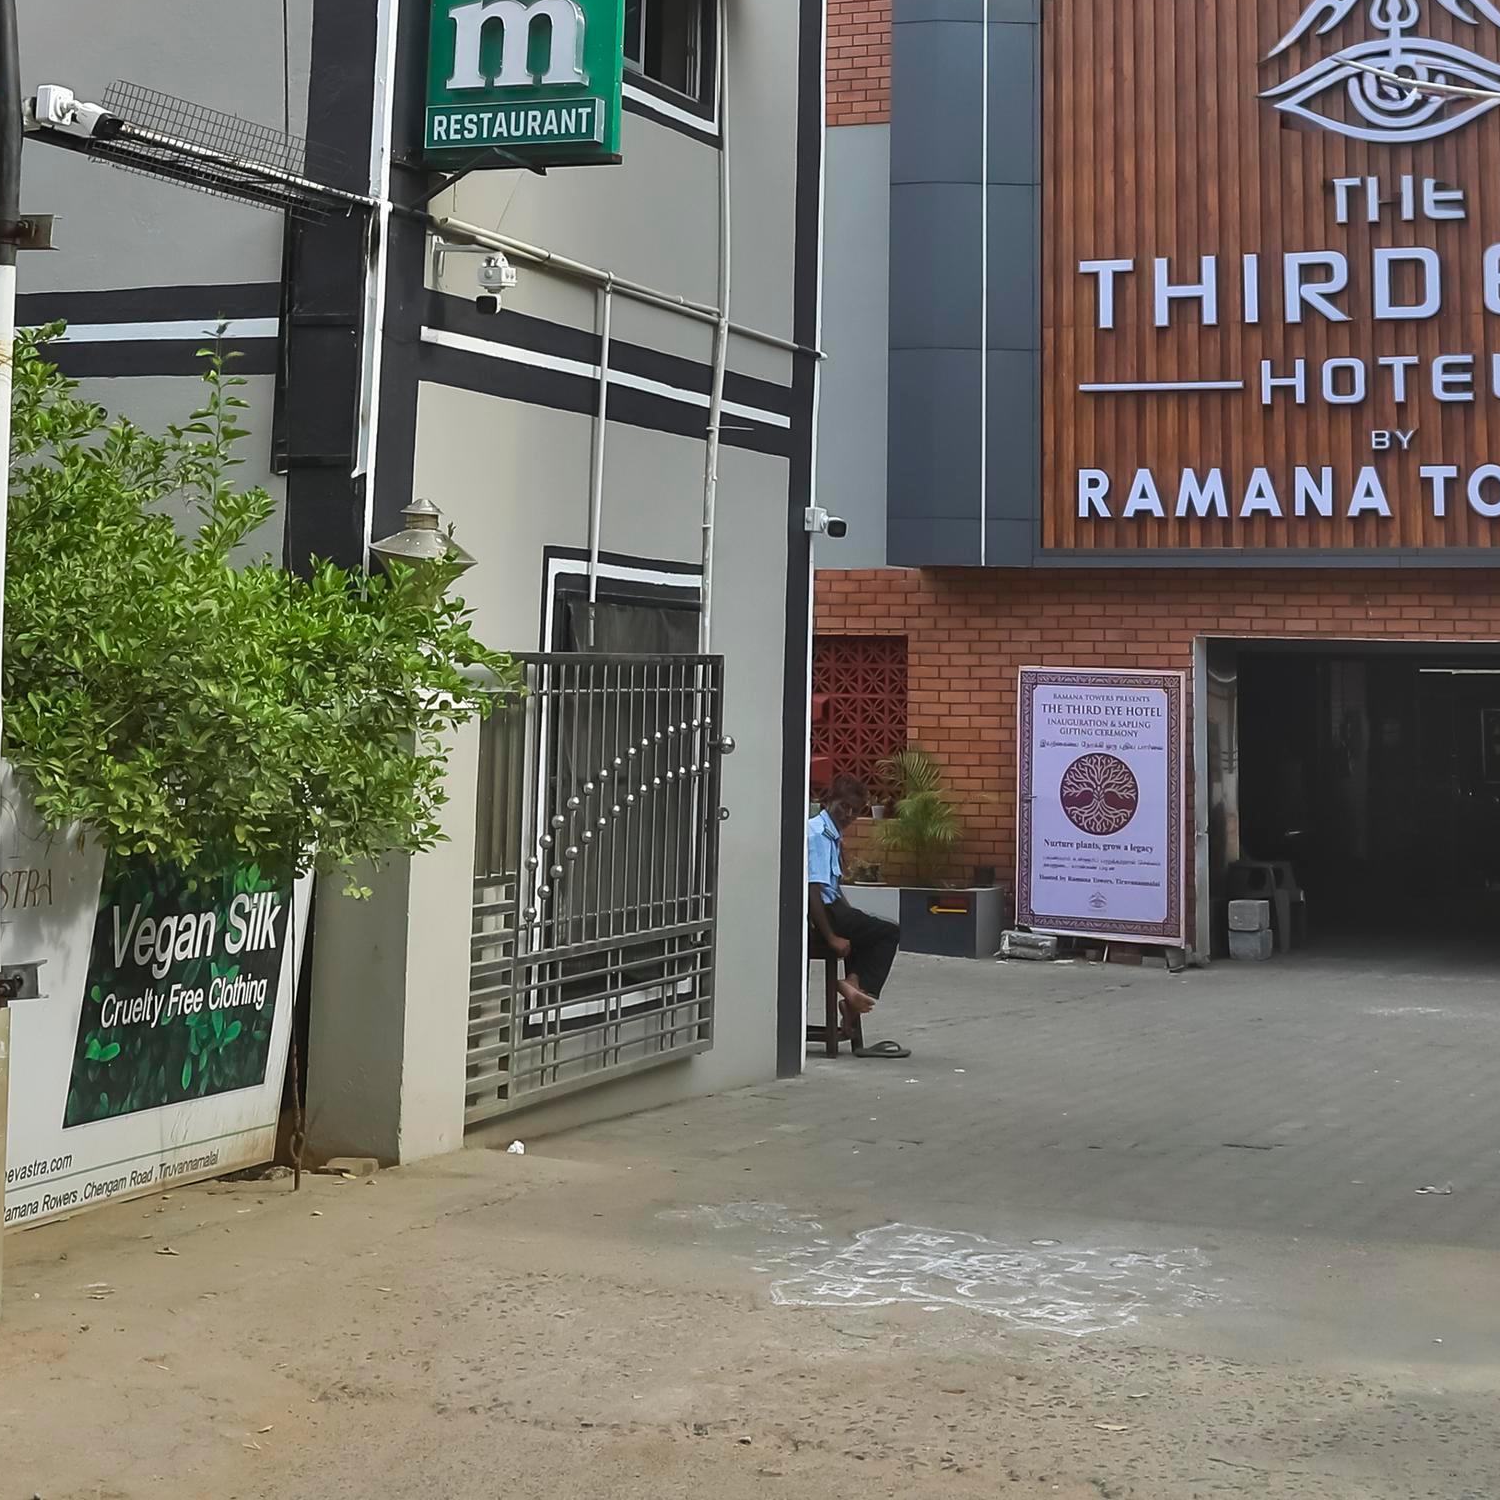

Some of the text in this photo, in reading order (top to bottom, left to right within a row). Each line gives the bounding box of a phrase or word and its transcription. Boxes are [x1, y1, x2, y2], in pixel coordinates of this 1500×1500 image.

[432, 106, 593, 143] RESTAURANT
[1079, 247, 1441, 329] THIRD
[1371, 429, 1415, 450] BY
[1077, 466, 1391, 518] RAMANA
[1041, 704, 1162, 717] THE THIRD EYE HOTEL
[1047, 718, 1108, 727] INAUGURATION
[1118, 720, 1151, 729] SAPLING
[1060, 727, 1138, 737] GIFTING CEREMONY
[1044, 839, 1074, 848] Nurture
[1076, 840, 1100, 850] plants,
[1102, 843, 1121, 851] grow
[1130, 843, 1153, 853] legacy
[112, 891, 282, 979] Vegan Silk
[101, 973, 268, 1028] Cruelty Free Clothing
[5, 1154, 73, 1184] evastra.com
[4, 1200, 39, 1222] amana
[42, 1190, 78, 1212] Rowers
[129, 1166, 154, 1187] Road
